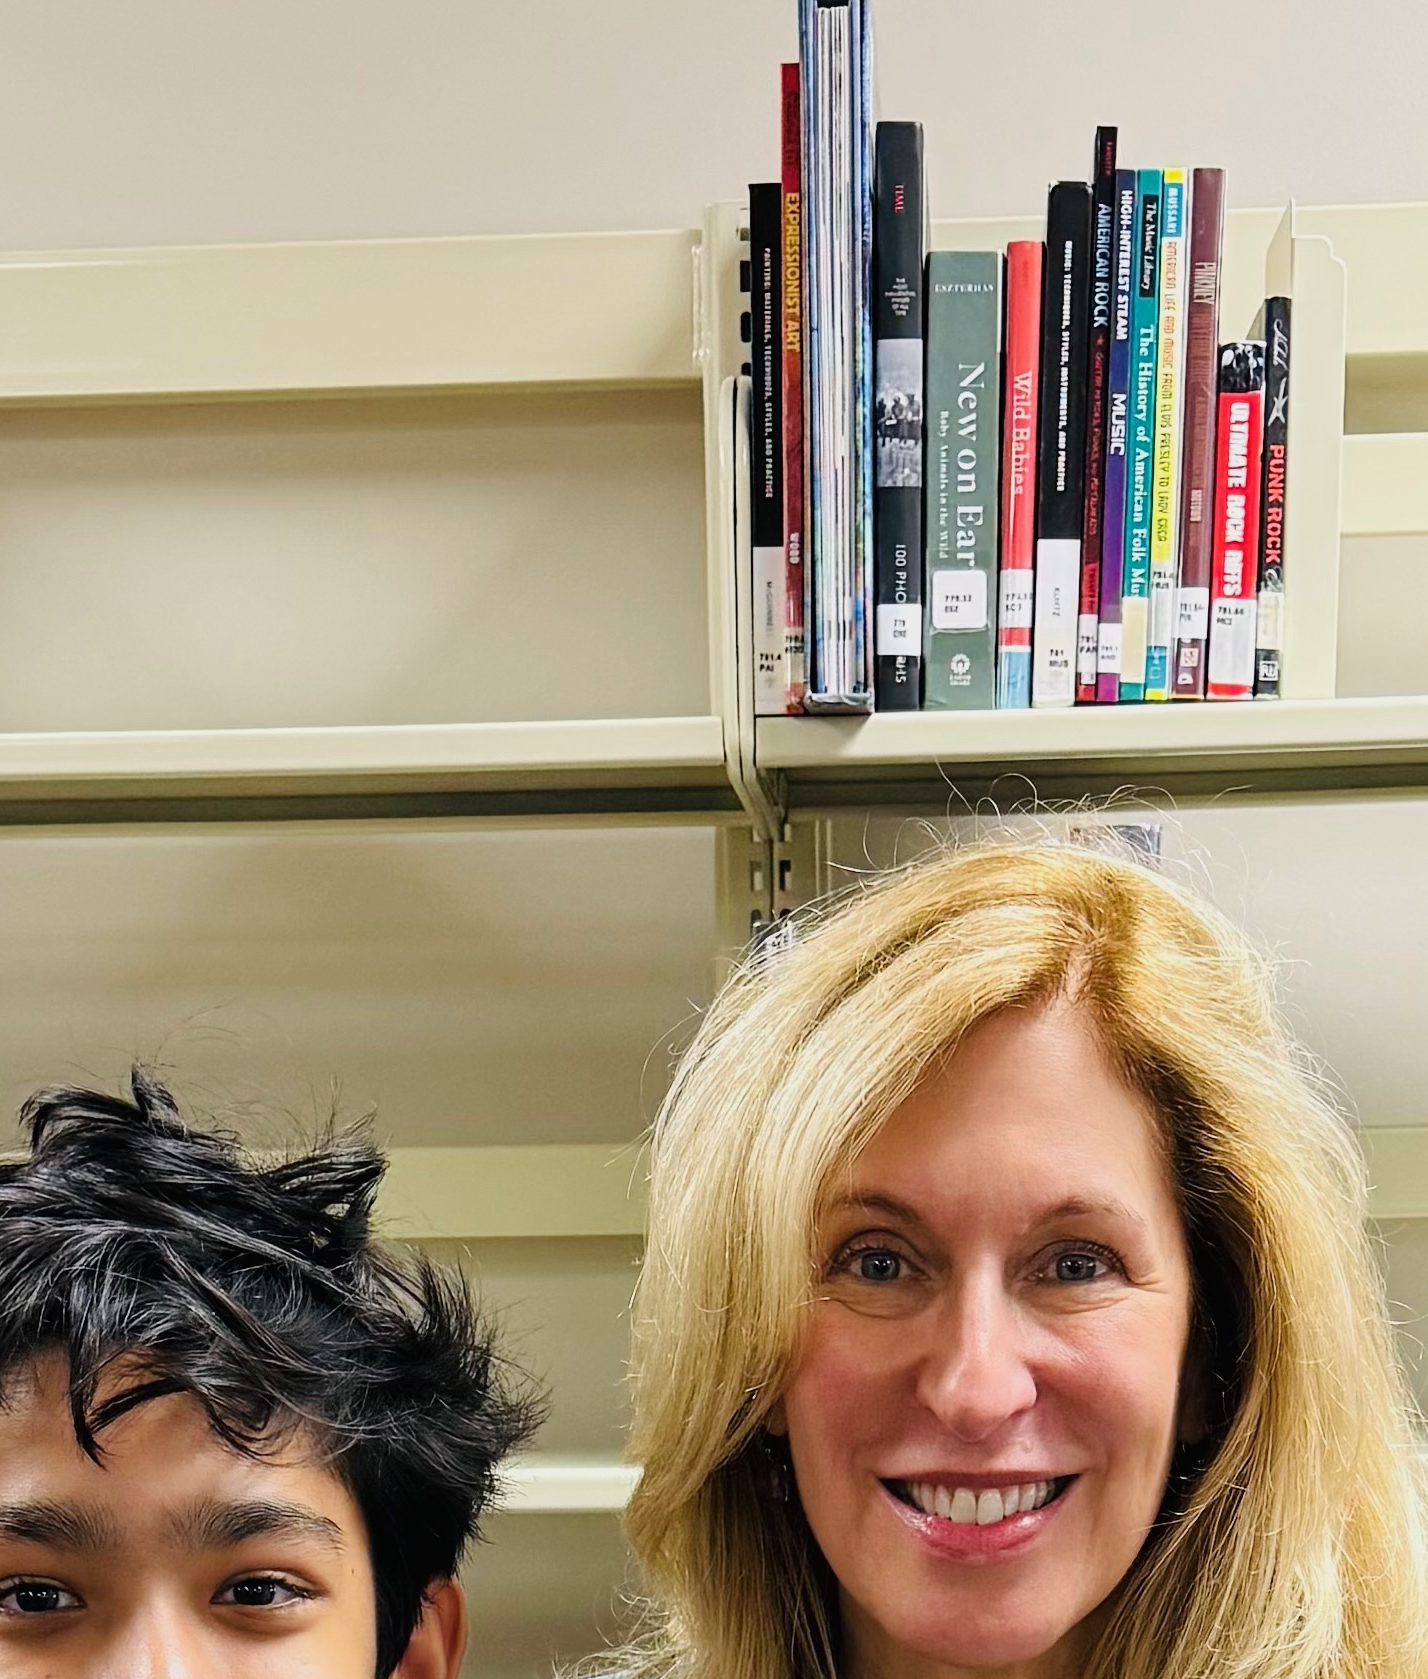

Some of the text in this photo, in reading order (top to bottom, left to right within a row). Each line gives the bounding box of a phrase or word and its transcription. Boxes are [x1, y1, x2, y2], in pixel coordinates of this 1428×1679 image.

[785, 193, 801, 353] EXPRESSIONIST ART
[1093, 203, 1112, 328] AMERICAN ROCK
[1141, 204, 1157, 290] The Music Library
[1110, 190, 1133, 456] HIGH-INTEREST STEAM MUSIC
[1157, 242, 1177, 513] AMERICAN LIFE AND MUSIC FROM ELVIS PRESLEY TO LADY
[956, 362, 985, 493] New on
[1012, 370, 1032, 494] Wild Babies
[1132, 325, 1154, 562] The History of American Folk
[1225, 402, 1250, 542] ULTIMATE ROCK
[895, 544, 907, 567] 100
[1266, 444, 1285, 563] PUNK ROCK
